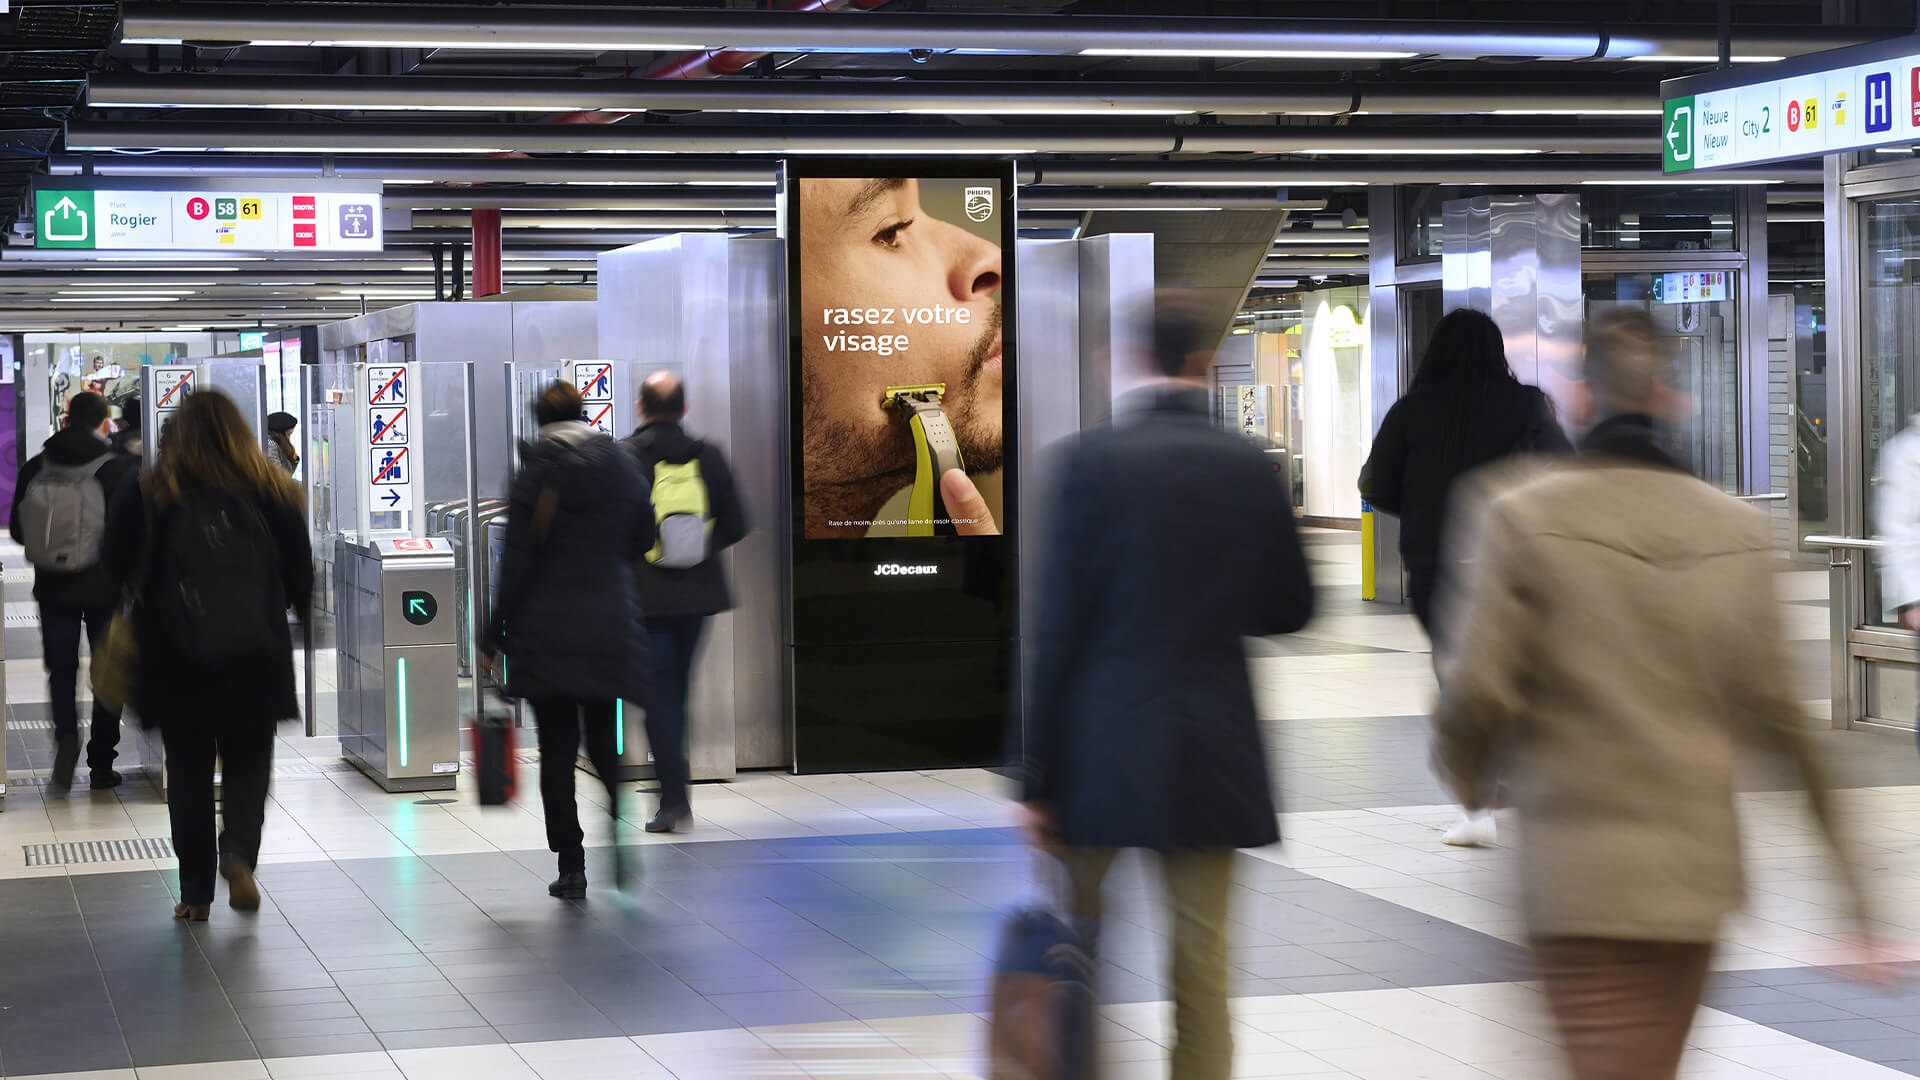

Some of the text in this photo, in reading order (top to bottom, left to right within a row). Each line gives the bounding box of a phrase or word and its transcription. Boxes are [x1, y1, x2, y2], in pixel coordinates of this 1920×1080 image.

[1869, 80, 1888, 126] H
[1703, 111, 1729, 126] Neuve
[1742, 106, 1770, 139] City 2
[1790, 105, 1816, 125] B 61
[1703, 133, 1729, 150] Nieuw
[192, 202, 259, 216] B 58 61
[110, 213, 157, 229] Rogier
[823, 304, 971, 325] rasez votre
[823, 330, 909, 356] visage
[874, 564, 938, 575] JCDecaux
